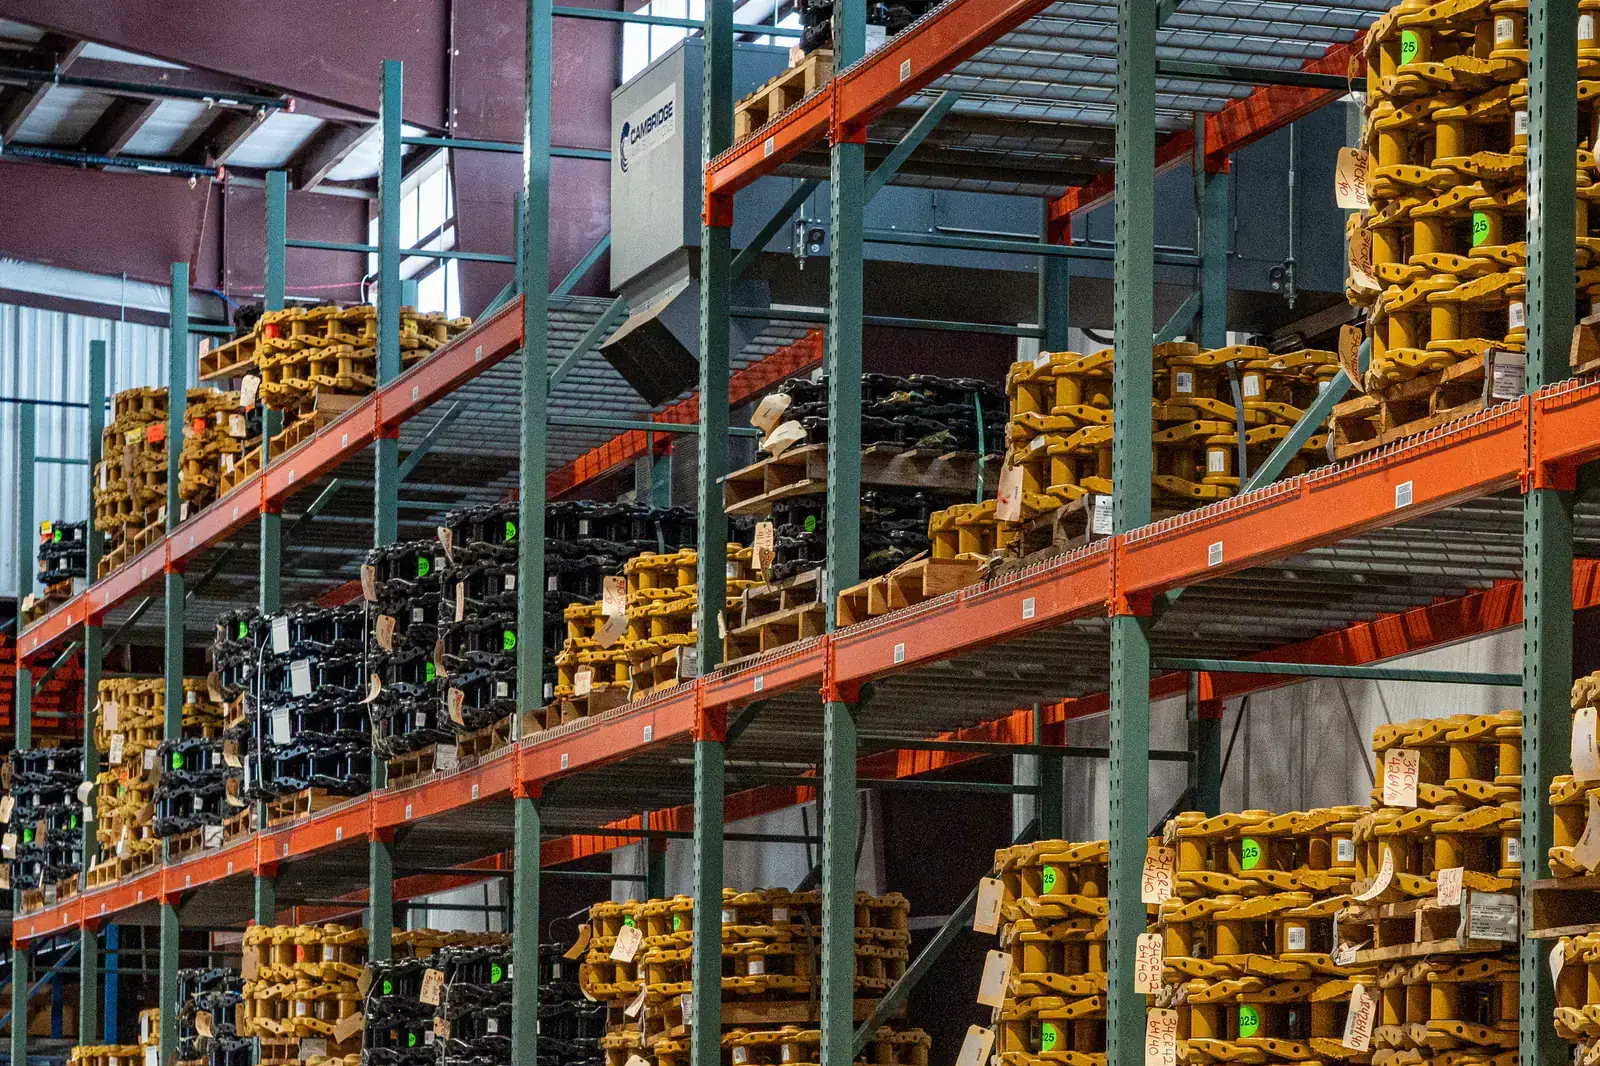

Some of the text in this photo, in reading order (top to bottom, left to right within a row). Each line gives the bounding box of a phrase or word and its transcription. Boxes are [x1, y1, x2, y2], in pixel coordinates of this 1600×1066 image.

[1402, 42, 1415, 52] 25
[631, 100, 673, 145] CAMBRIDGE
[1474, 220, 1487, 234] 25
[1243, 848, 1258, 859] 025
[1044, 874, 1054, 884] 25
[1148, 941, 1161, 991] 34CR42
[1241, 1016, 1257, 1026] 025
[1044, 1033, 1055, 1042] 25
[1162, 1018, 1177, 1066] 34CR42
